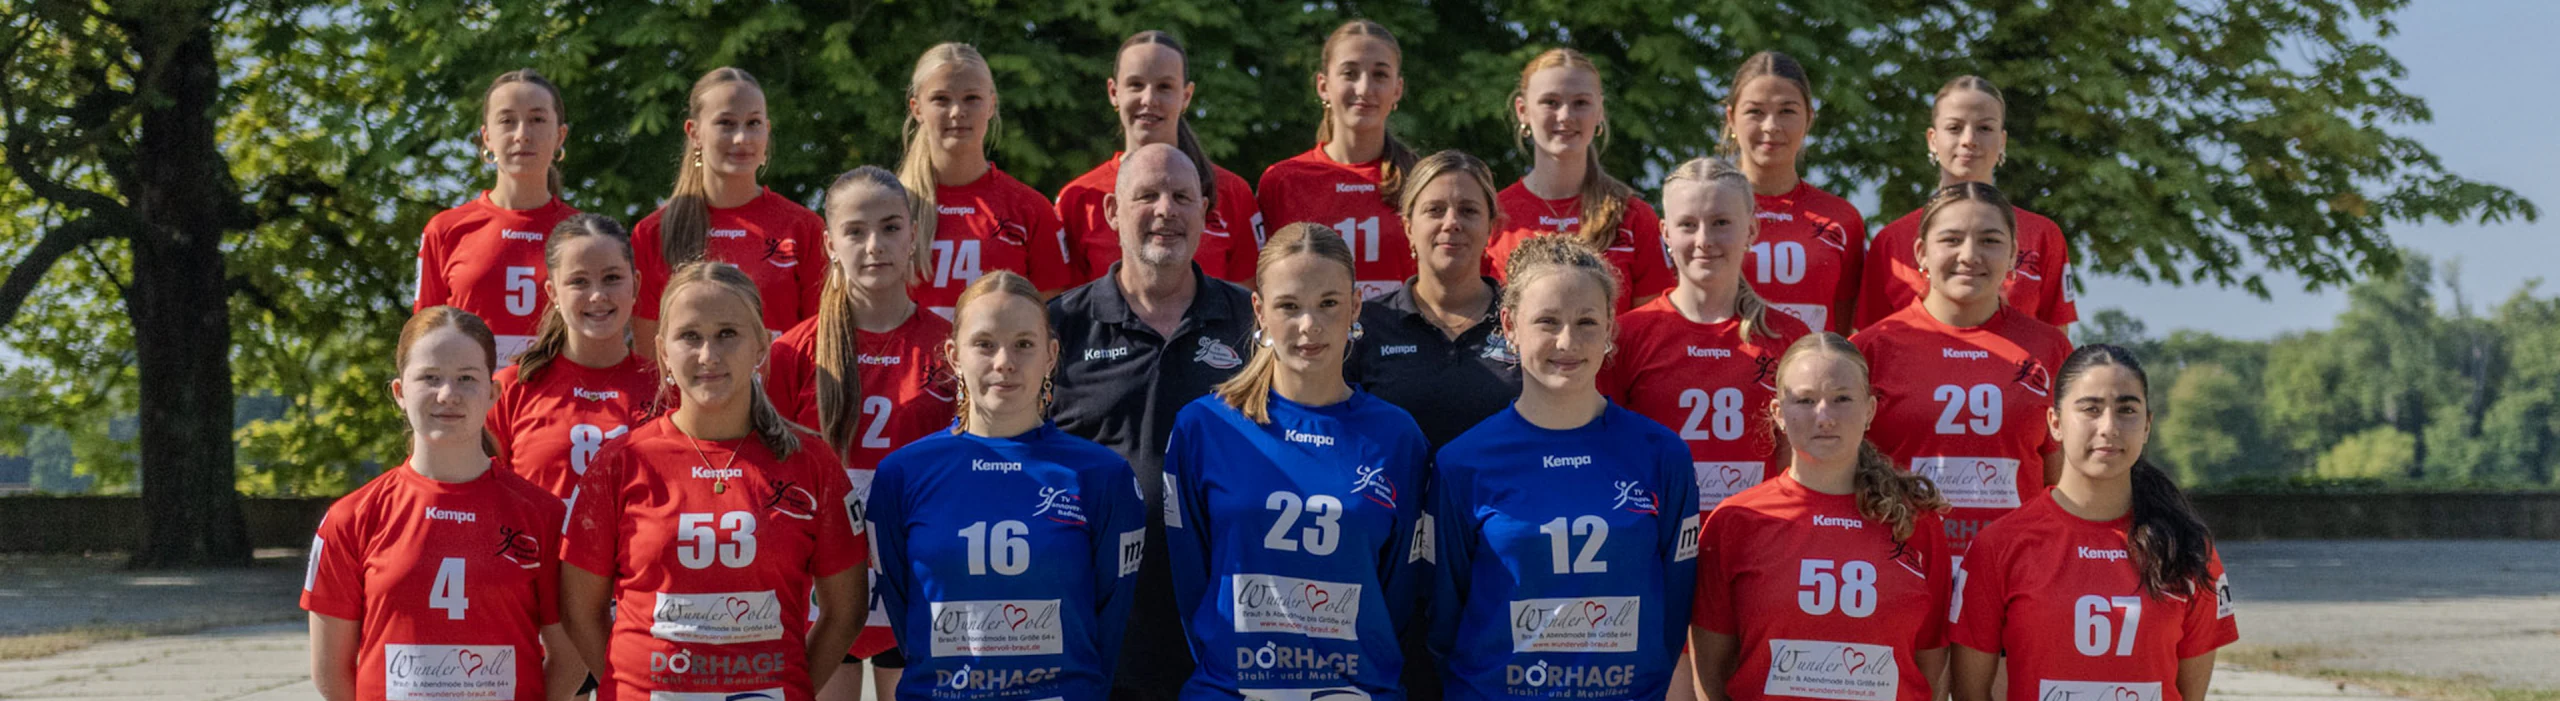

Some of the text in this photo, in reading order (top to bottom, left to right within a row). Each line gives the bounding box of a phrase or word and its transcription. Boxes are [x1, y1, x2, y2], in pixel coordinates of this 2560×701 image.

[1336, 183, 1376, 193] Kempa
[502, 229, 543, 242] Kempa
[1333, 216, 1380, 262] 11
[932, 240, 983, 288] 74
[1751, 241, 1807, 285] 10
[505, 266, 537, 316] 5
[1084, 346, 1128, 361] Kempa
[1381, 345, 1417, 356] Kempa
[1687, 345, 1731, 359] Kempa
[1942, 348, 1988, 360] Kempa
[861, 395, 893, 448] 2
[1679, 387, 1745, 441] 28
[1933, 383, 2003, 435] 29
[1285, 429, 1335, 447] Kempa
[691, 466, 743, 480] Kempa
[972, 459, 1022, 474] Kempa
[1543, 455, 1592, 469] Kempa
[425, 506, 476, 524] Kempa
[1264, 490, 1343, 556] 23
[1813, 515, 1862, 530] Kempa
[677, 510, 757, 570] 53
[958, 520, 1030, 576] 16
[1540, 515, 1609, 574] 12
[2078, 546, 2128, 562] Kempa
[429, 557, 469, 620] 4
[1798, 559, 1877, 618] 58
[2074, 594, 2142, 656] 67
[1506, 659, 1636, 687] DÖRHAGE
